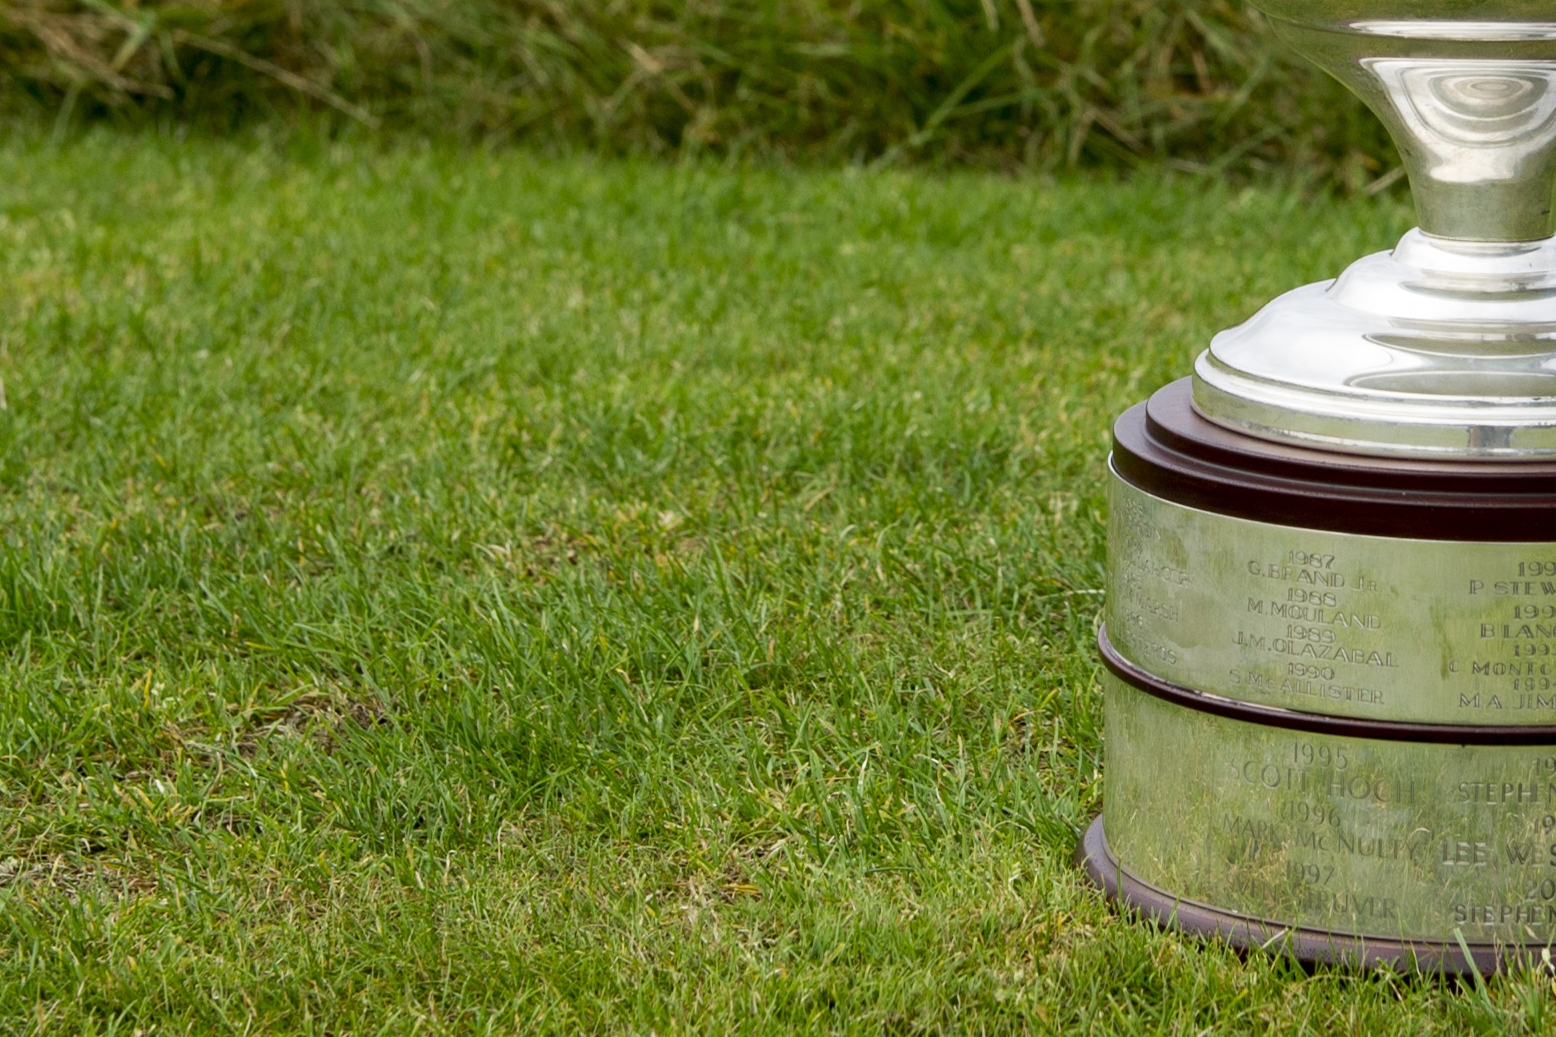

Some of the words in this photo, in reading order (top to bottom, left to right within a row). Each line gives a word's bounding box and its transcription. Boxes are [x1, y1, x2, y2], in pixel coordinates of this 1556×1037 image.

[1288, 550, 1336, 570] 1987
[1287, 587, 1337, 608] 1988
[1286, 624, 1337, 644] 1989
[1287, 662, 1336, 681] 1990
[1293, 741, 1349, 771] 1995
[1325, 772, 1417, 804] HOCH
[1442, 840, 1488, 866] LEE
